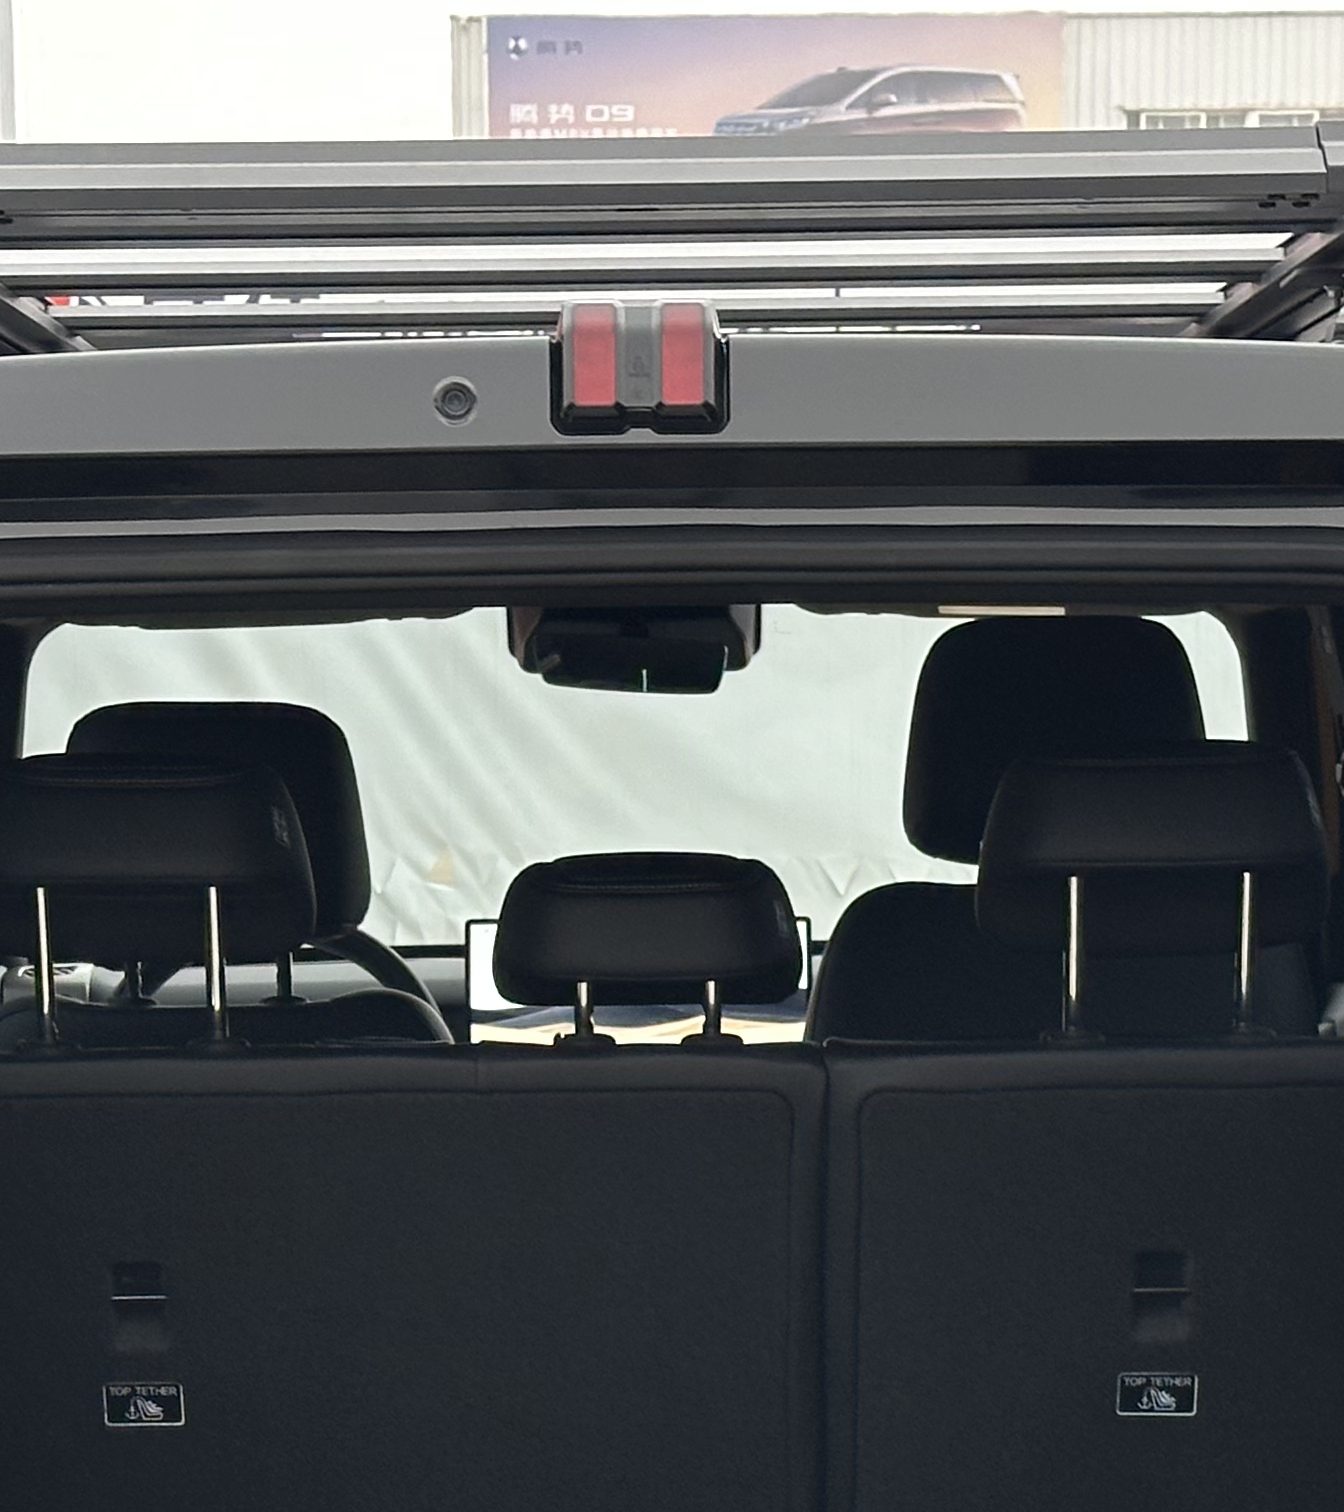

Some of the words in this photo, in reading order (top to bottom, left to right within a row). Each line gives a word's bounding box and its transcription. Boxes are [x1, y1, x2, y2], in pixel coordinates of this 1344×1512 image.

[1123, 1377, 1147, 1387] TOP
[1150, 1376, 1192, 1387] TETHER
[109, 1387, 132, 1397] TOP
[135, 1386, 178, 1397] TETHER
